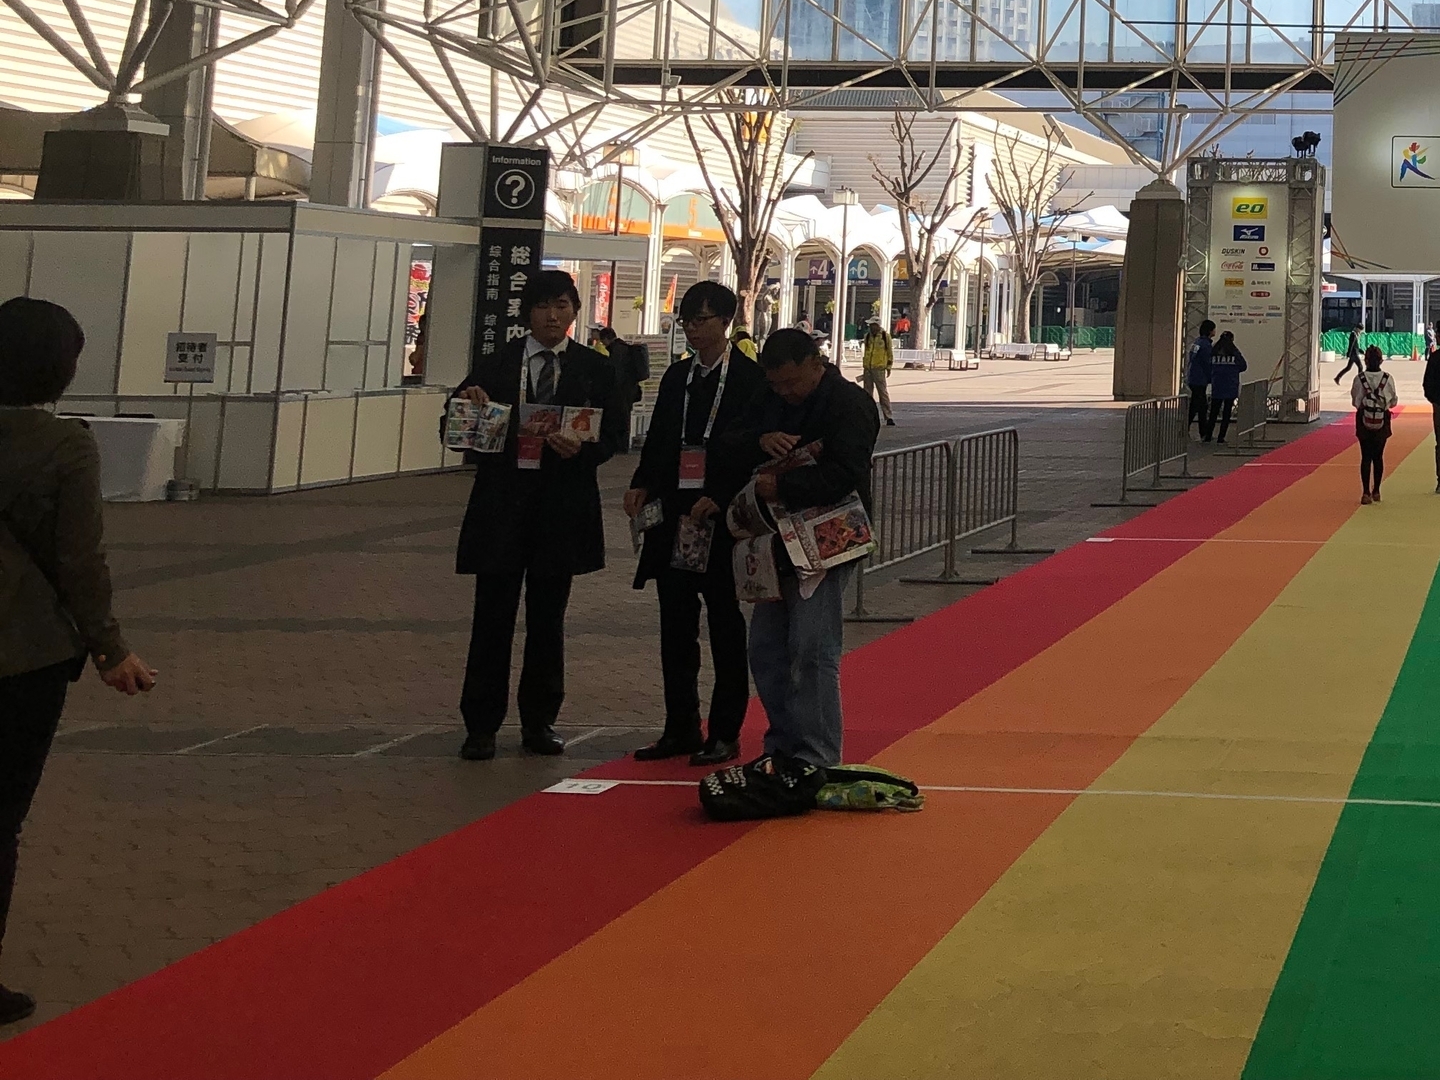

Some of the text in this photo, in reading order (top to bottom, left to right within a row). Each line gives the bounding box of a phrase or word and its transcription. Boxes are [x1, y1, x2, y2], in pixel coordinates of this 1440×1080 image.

[492, 155, 542, 166] Information
[1236, 204, 1264, 213] eo
[817, 260, 829, 279] 4
[856, 260, 868, 279] 6
